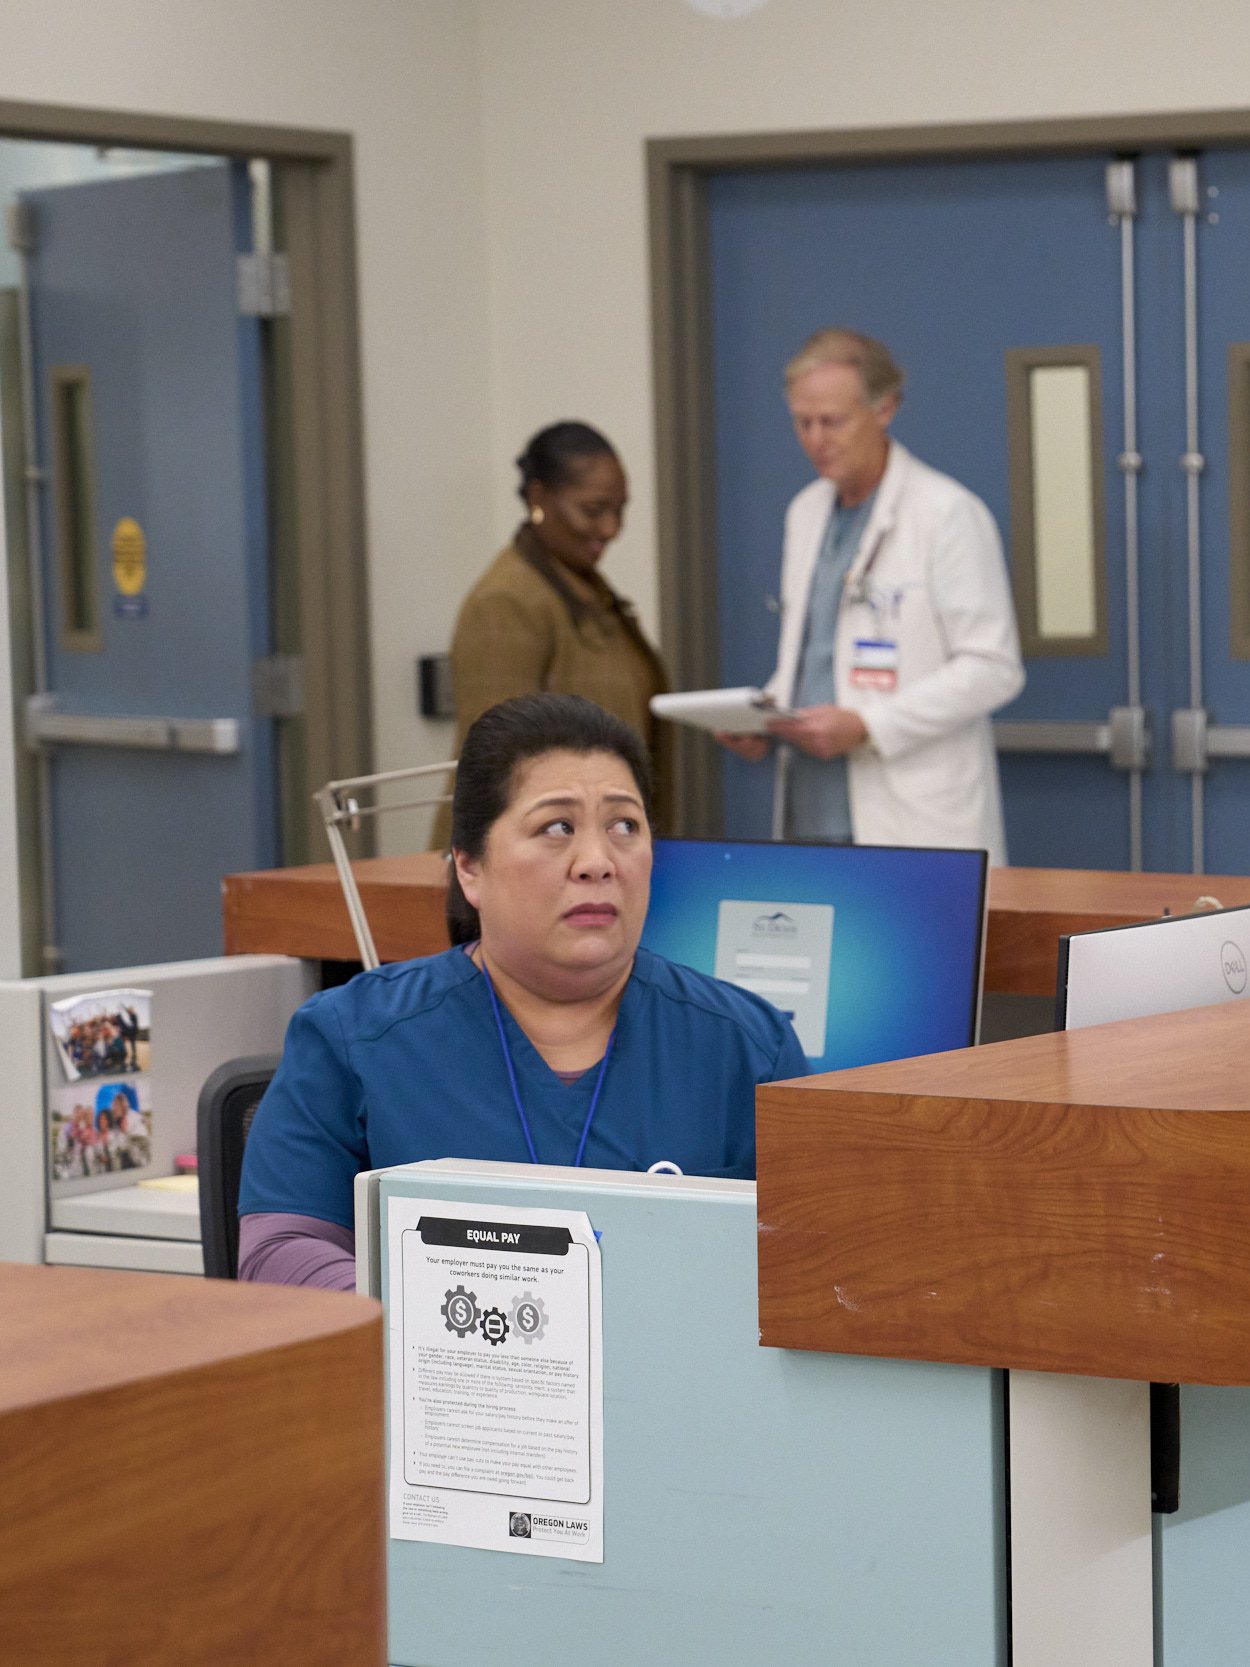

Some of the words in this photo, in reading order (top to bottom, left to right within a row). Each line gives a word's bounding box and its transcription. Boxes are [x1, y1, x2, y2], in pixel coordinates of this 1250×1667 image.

[1224, 961, 1245, 975] DELL
[466, 1229, 499, 1243] EQUAL
[501, 1232, 521, 1244] PAY
[426, 1256, 440, 1264] Your
[441, 1258, 468, 1268] employer
[450, 1268, 480, 1278] coworkers
[482, 1272, 498, 1281] doing
[500, 1273, 520, 1281] similar
[404, 1493, 430, 1501] CONTACT
[533, 1518, 564, 1528] OREGON
[566, 1521, 588, 1530] LAWS
